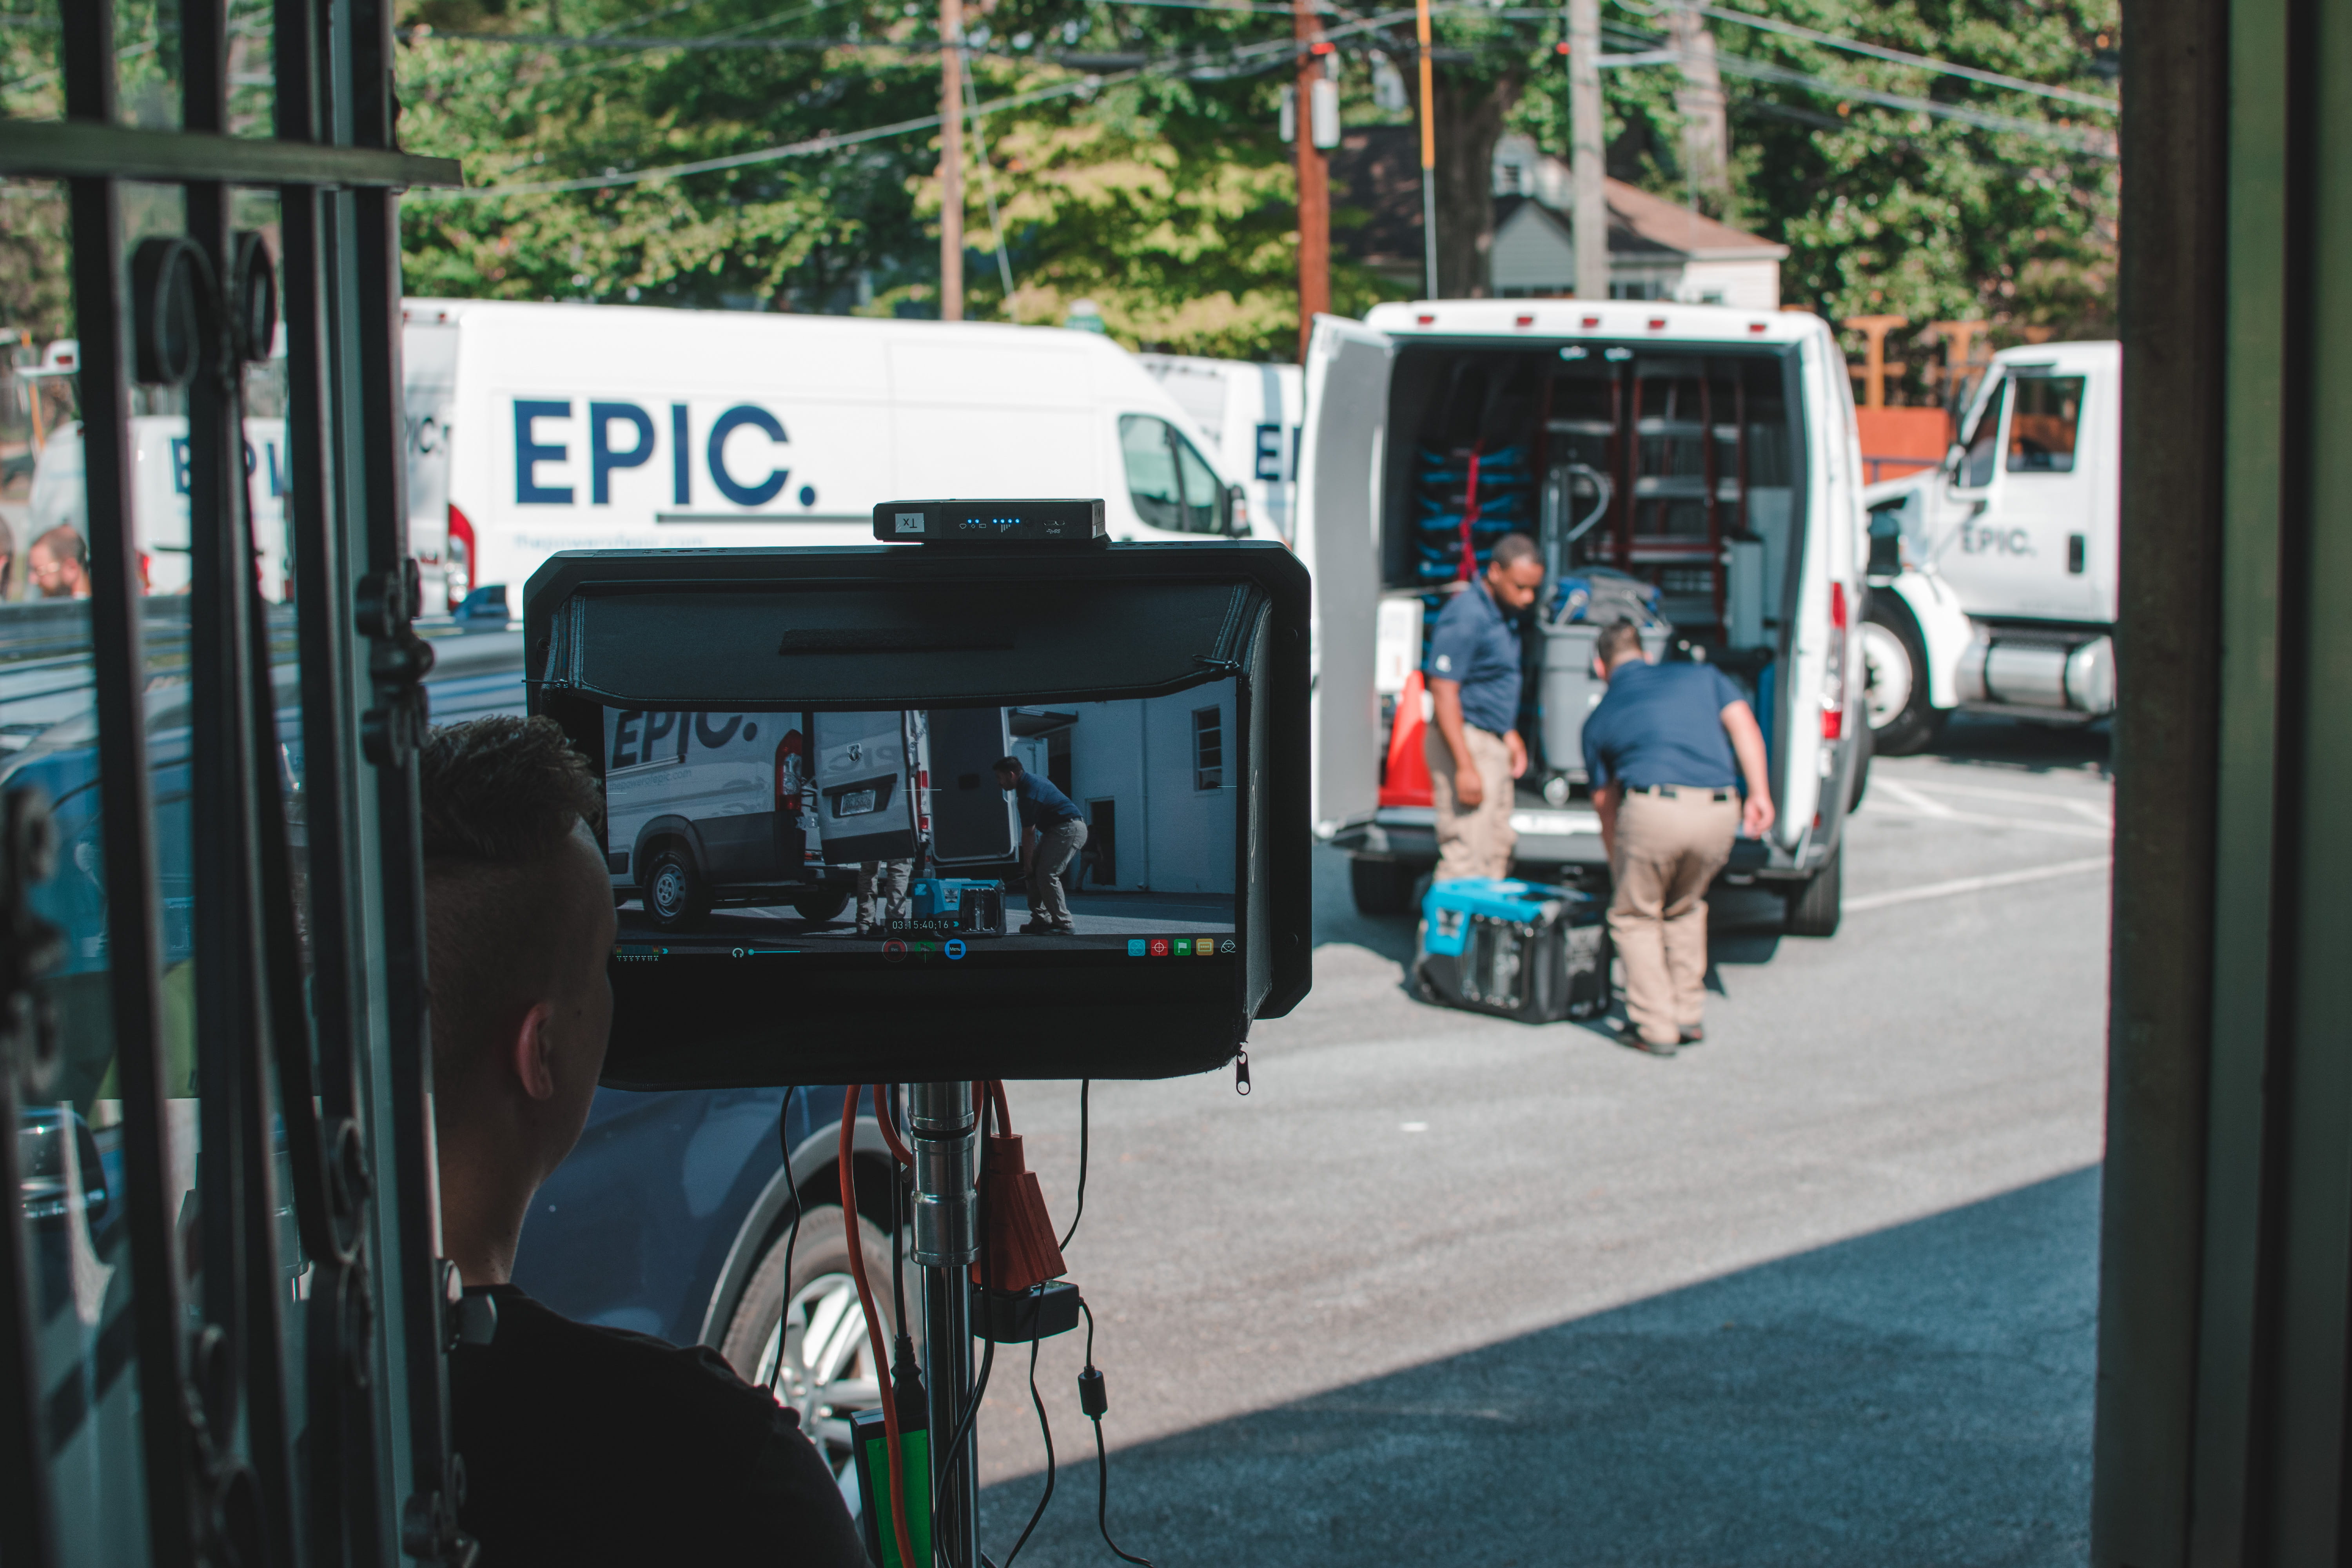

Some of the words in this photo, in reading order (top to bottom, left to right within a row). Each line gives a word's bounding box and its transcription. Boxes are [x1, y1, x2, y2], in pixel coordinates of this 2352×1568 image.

[514, 400, 817, 507] EPIC.
[903, 518, 918, 528] Tx
[612, 711, 758, 769] EPIC.
[893, 920, 949, 929] 03:15:40;16
